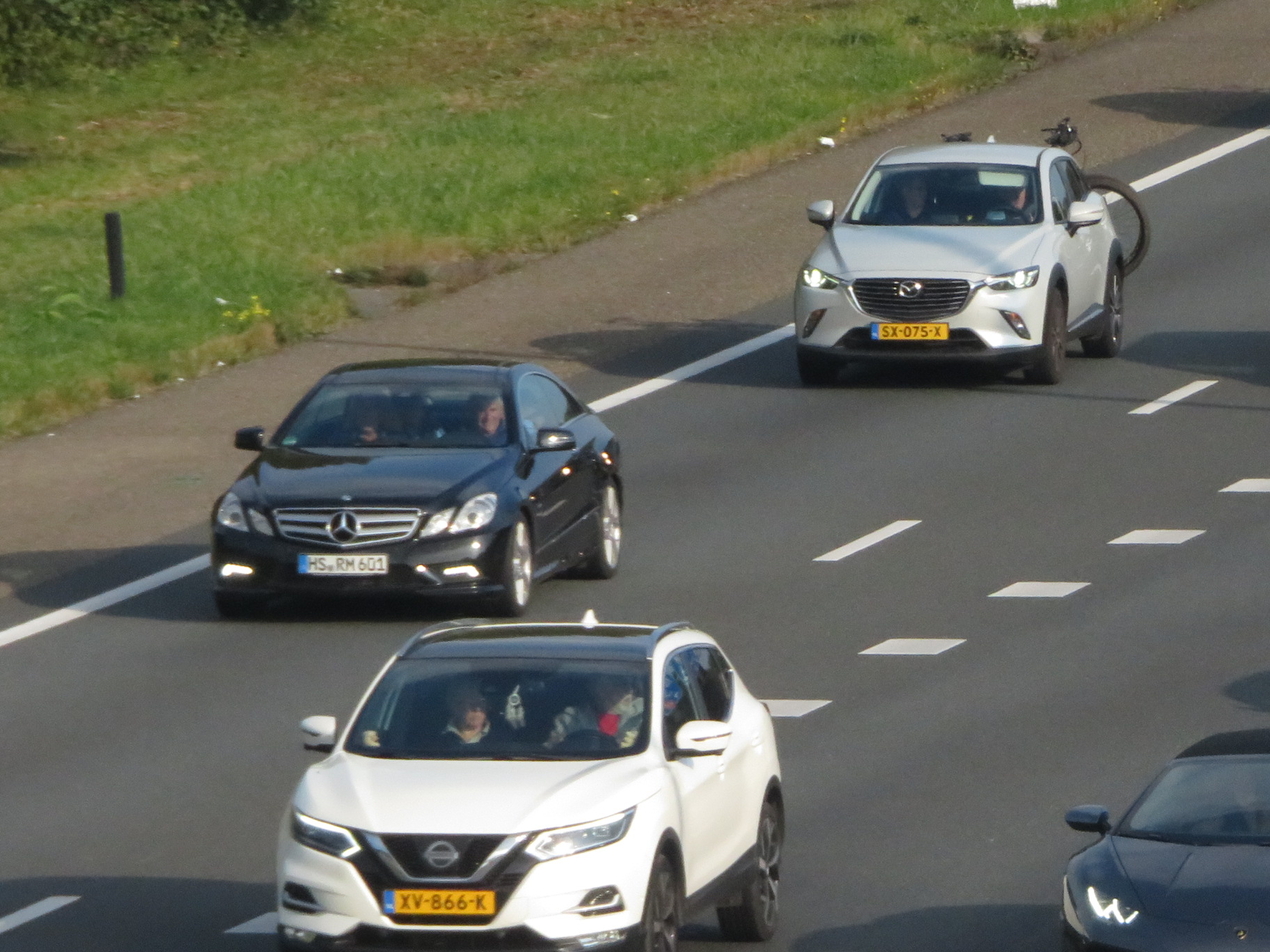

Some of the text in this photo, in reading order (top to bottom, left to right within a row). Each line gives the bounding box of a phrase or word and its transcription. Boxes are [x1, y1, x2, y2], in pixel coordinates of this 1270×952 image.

[881, 325, 942, 338] SX-075-X
[308, 557, 385, 572] HS RM 601
[400, 893, 488, 911] XV-866-K
